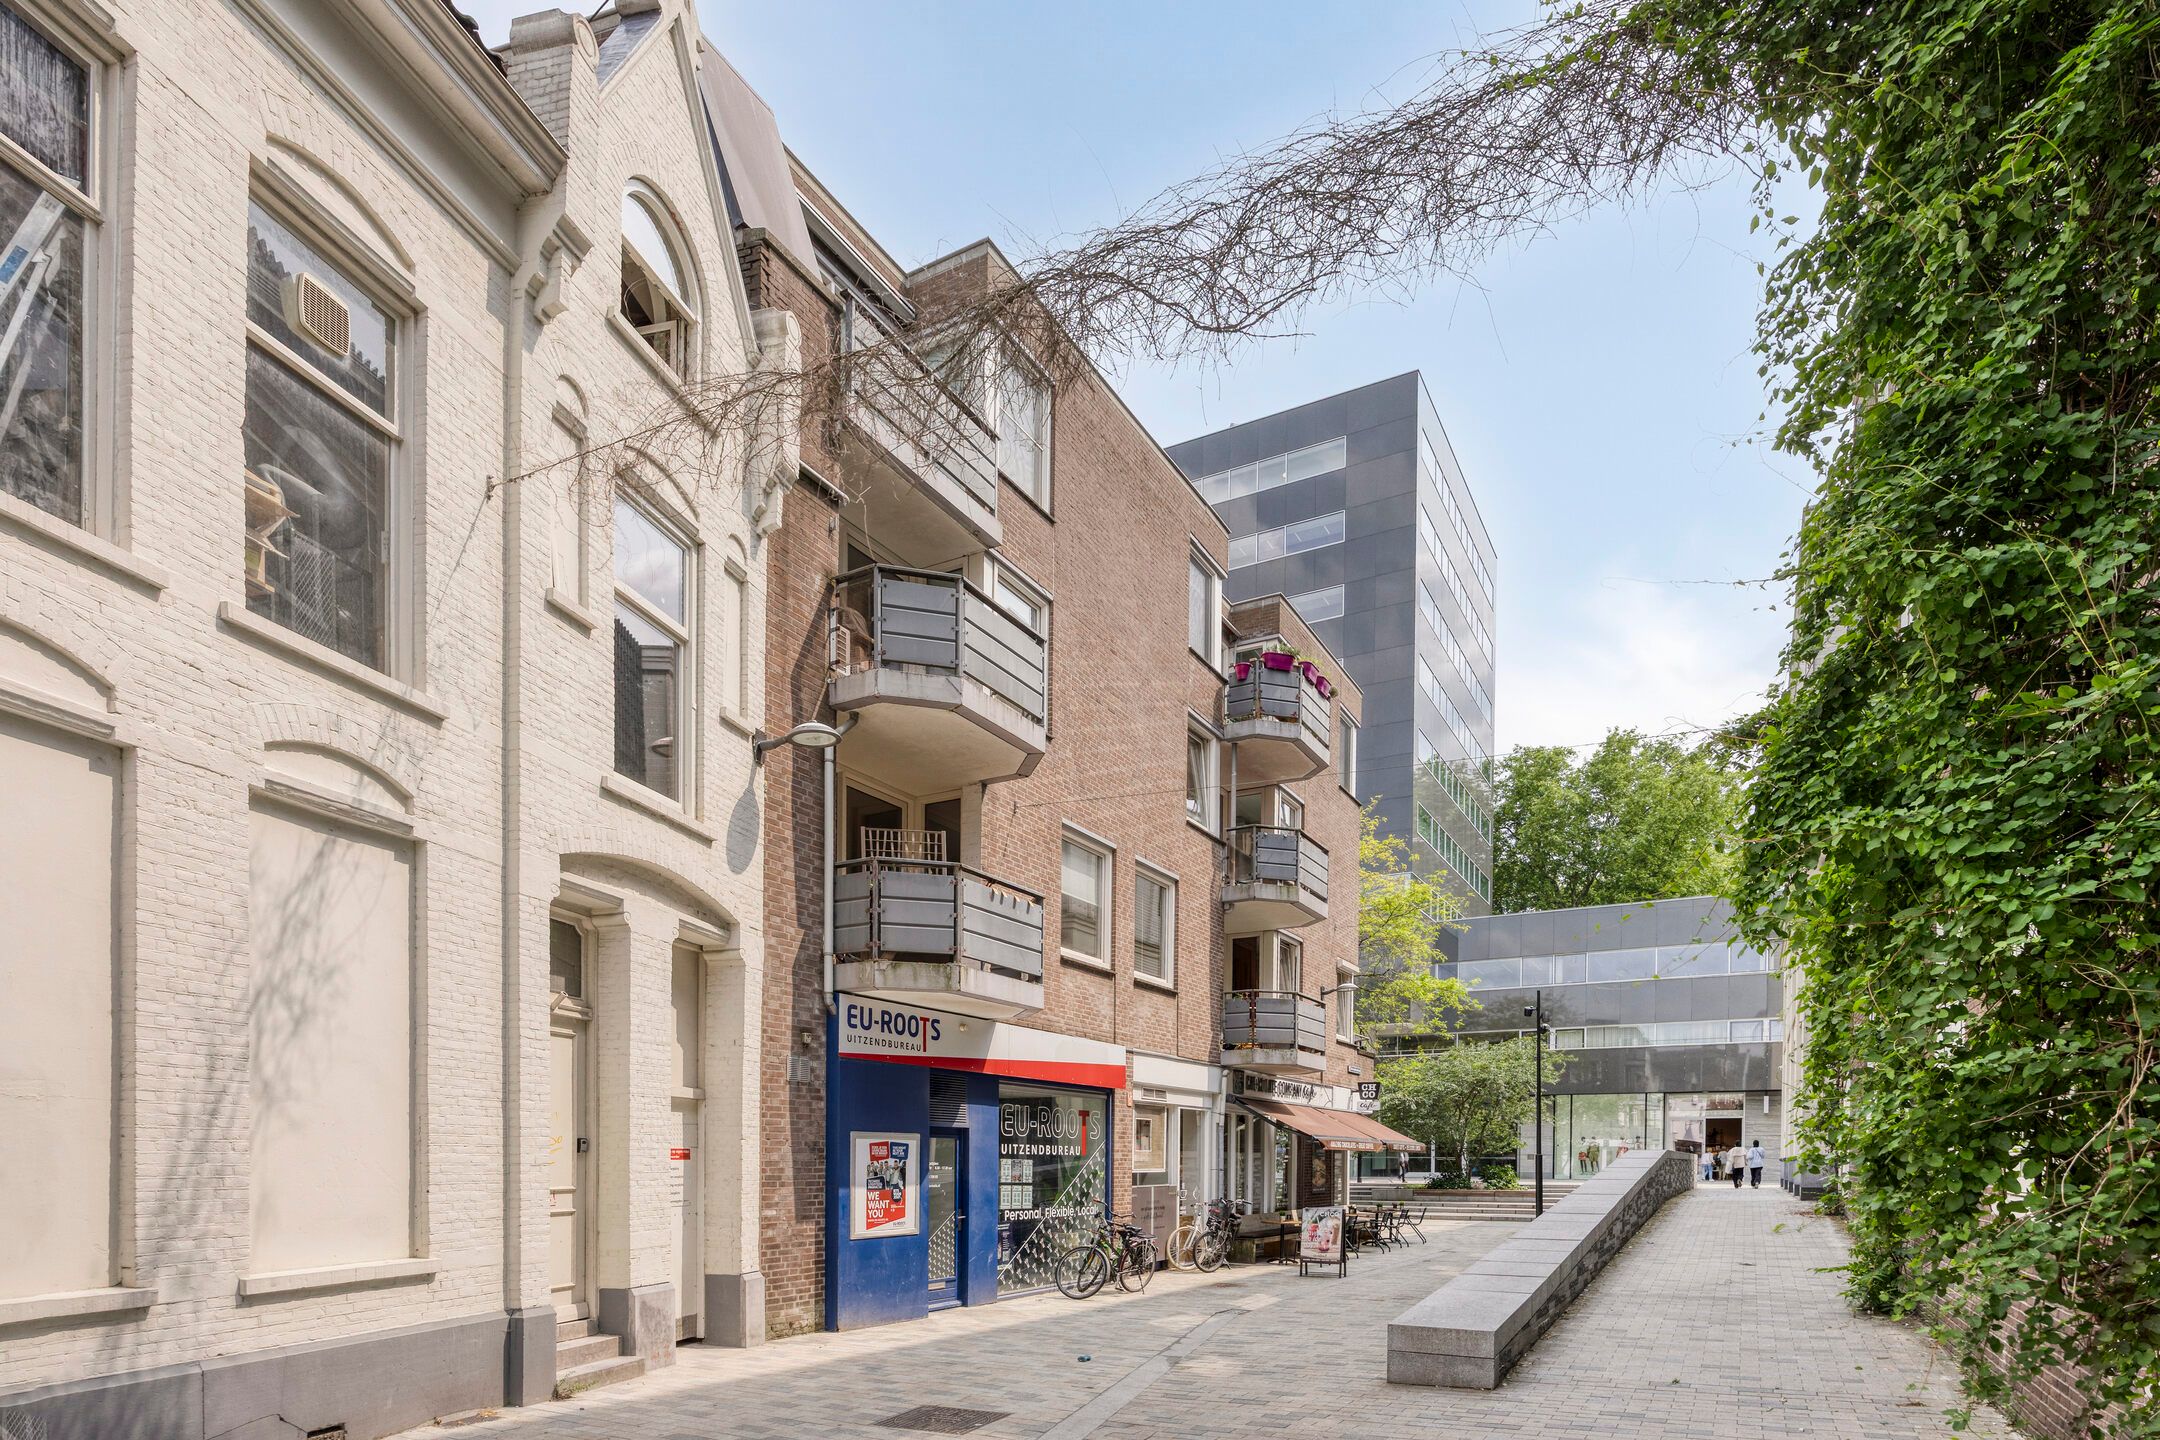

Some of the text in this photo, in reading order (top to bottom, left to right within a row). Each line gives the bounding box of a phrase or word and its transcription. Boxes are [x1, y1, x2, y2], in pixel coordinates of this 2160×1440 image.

[847, 1004, 941, 1052] EU-ROOTS
[846, 1034, 922, 1052] UITZENDBUREAU
[1361, 1083, 1377, 1091] CH
[1361, 1090, 1376, 1099] CO
[1001, 1104, 1101, 1157] EU-ROOTS
[1001, 1143, 1081, 1156] UITZENDBUREAU
[867, 1191, 880, 1200] WE
[867, 1199, 890, 1210] WANT
[867, 1208, 884, 1218] YOU
